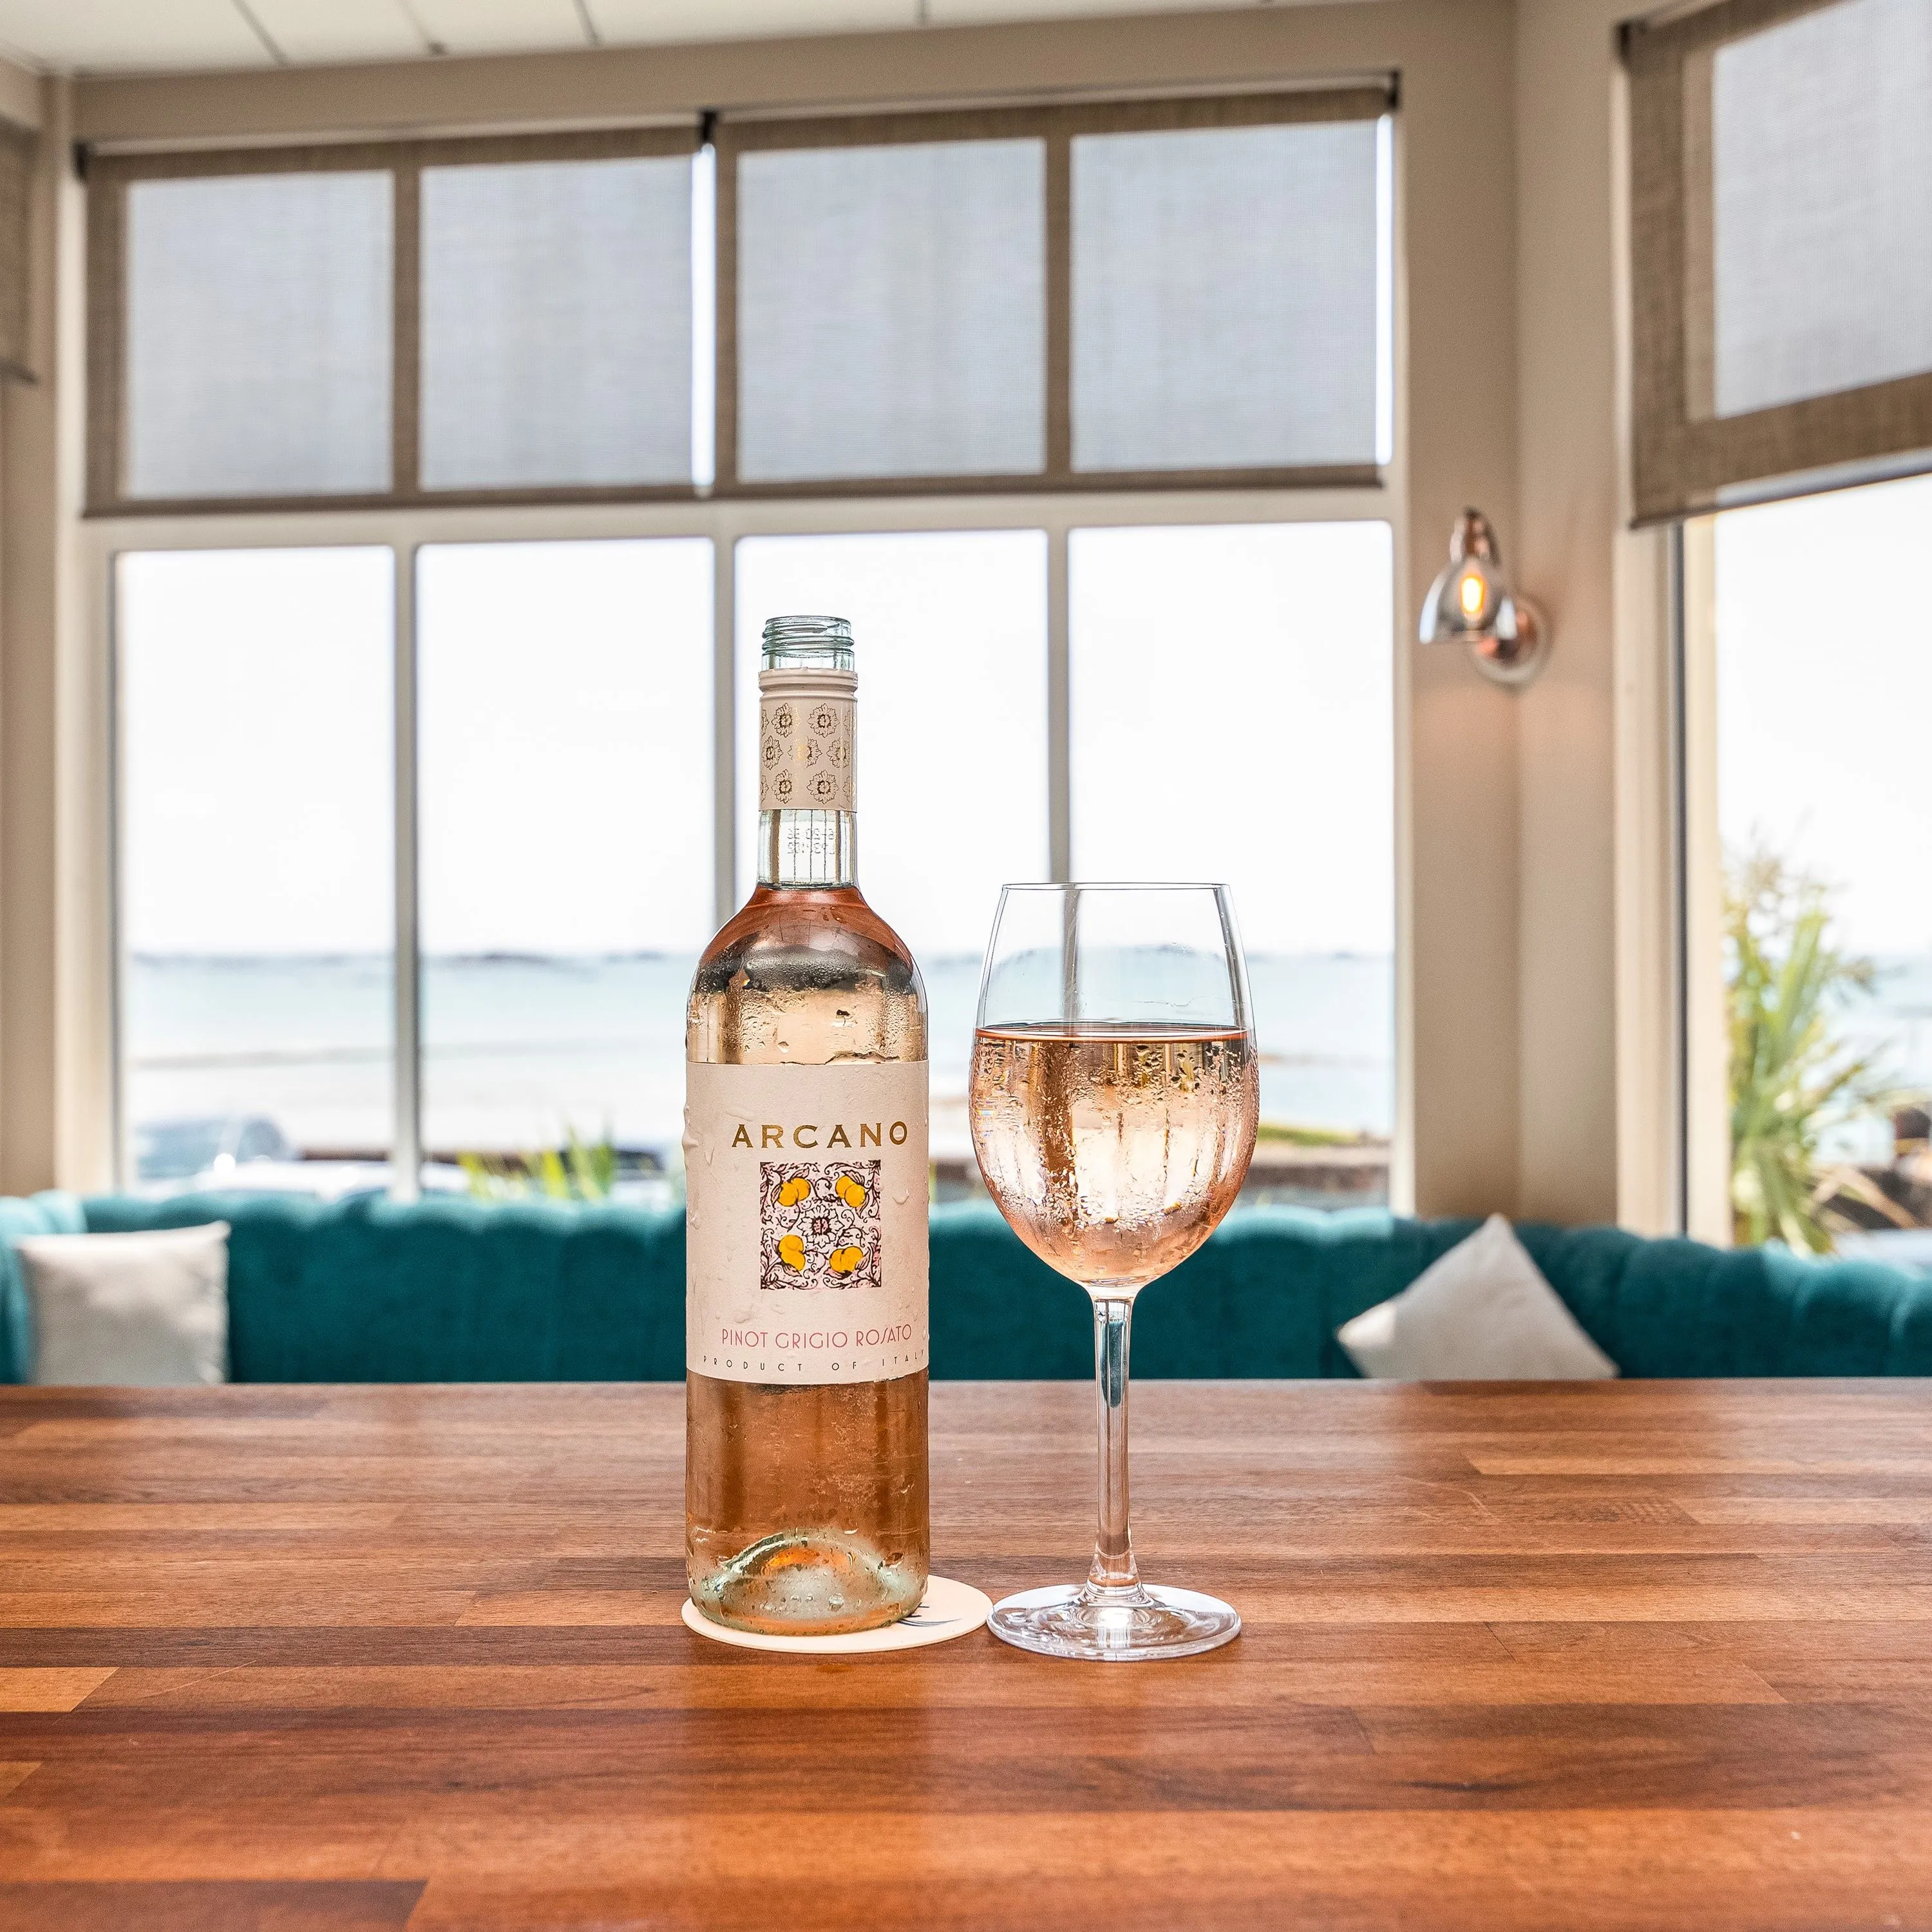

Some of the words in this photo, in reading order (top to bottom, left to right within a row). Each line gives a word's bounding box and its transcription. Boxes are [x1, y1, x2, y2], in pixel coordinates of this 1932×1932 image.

[731, 1121, 908, 1149] ARCANO
[721, 1328, 768, 1348] PINOT
[775, 1332, 848, 1349] GRIGIO
[856, 1323, 913, 1347] ROSATO
[703, 1355, 802, 1372] PRODUCT
[831, 1361, 857, 1371] OF
[882, 1349, 924, 1367] ITALY
